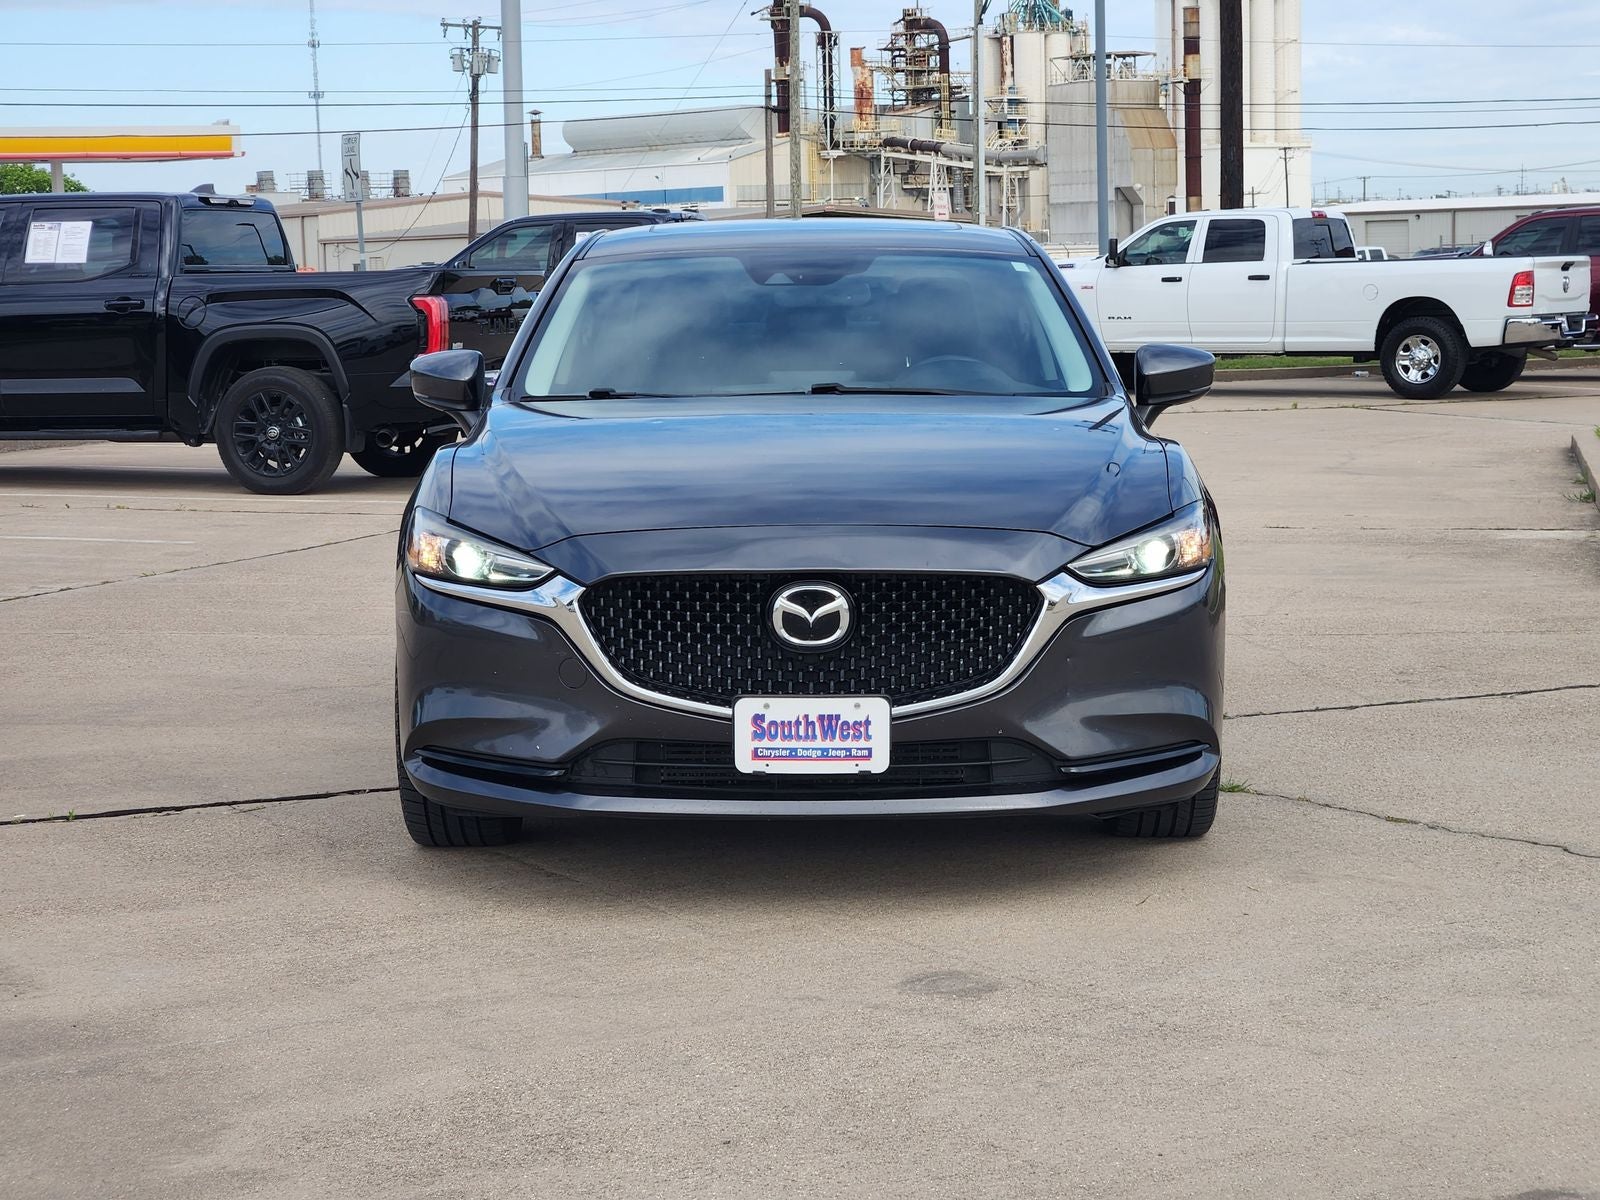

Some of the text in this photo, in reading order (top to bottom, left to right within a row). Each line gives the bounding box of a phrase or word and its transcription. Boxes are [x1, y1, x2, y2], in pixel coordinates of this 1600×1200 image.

[751, 713, 872, 742] SouthWest
[757, 748, 869, 758] Chrysler Dodge Jeep Ram
